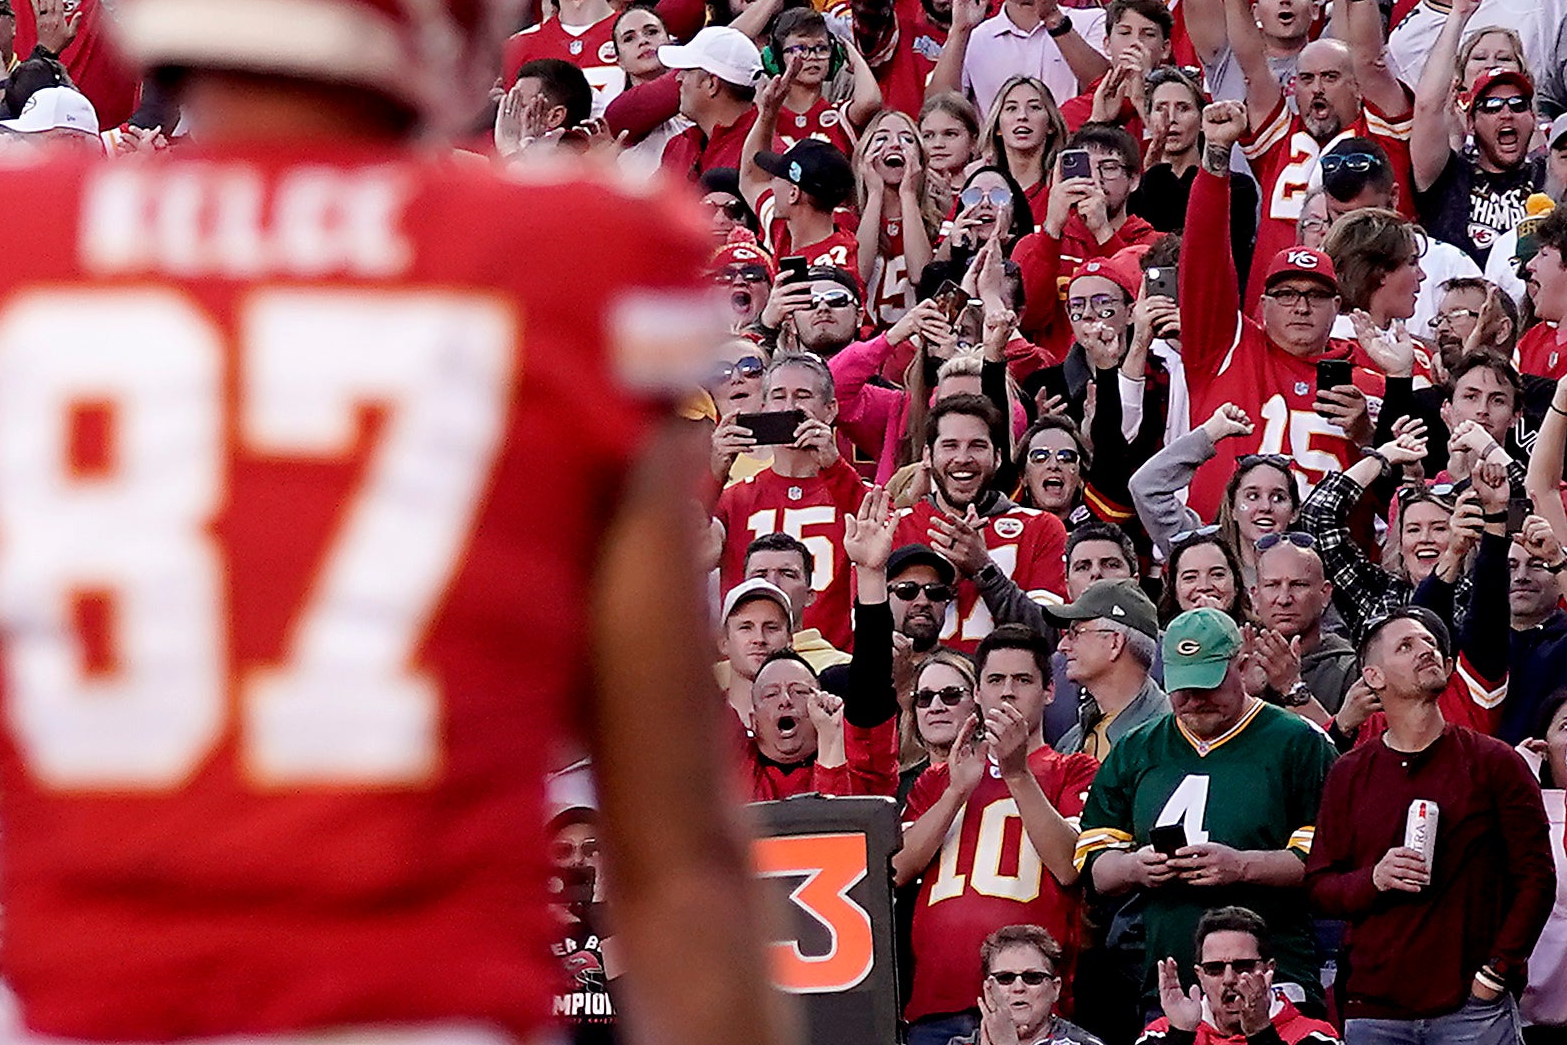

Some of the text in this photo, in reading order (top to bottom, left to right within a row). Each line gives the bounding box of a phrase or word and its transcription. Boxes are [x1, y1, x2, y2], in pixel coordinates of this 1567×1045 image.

[80, 169, 416, 276] KELCE
[1287, 251, 1317, 269] KC
[1258, 393, 1359, 509] 15
[748, 505, 836, 593] 15
[1176, 640, 1201, 657] G
[929, 798, 1043, 912] 10
[1155, 774, 1211, 844] 4
[752, 833, 875, 993] 3
